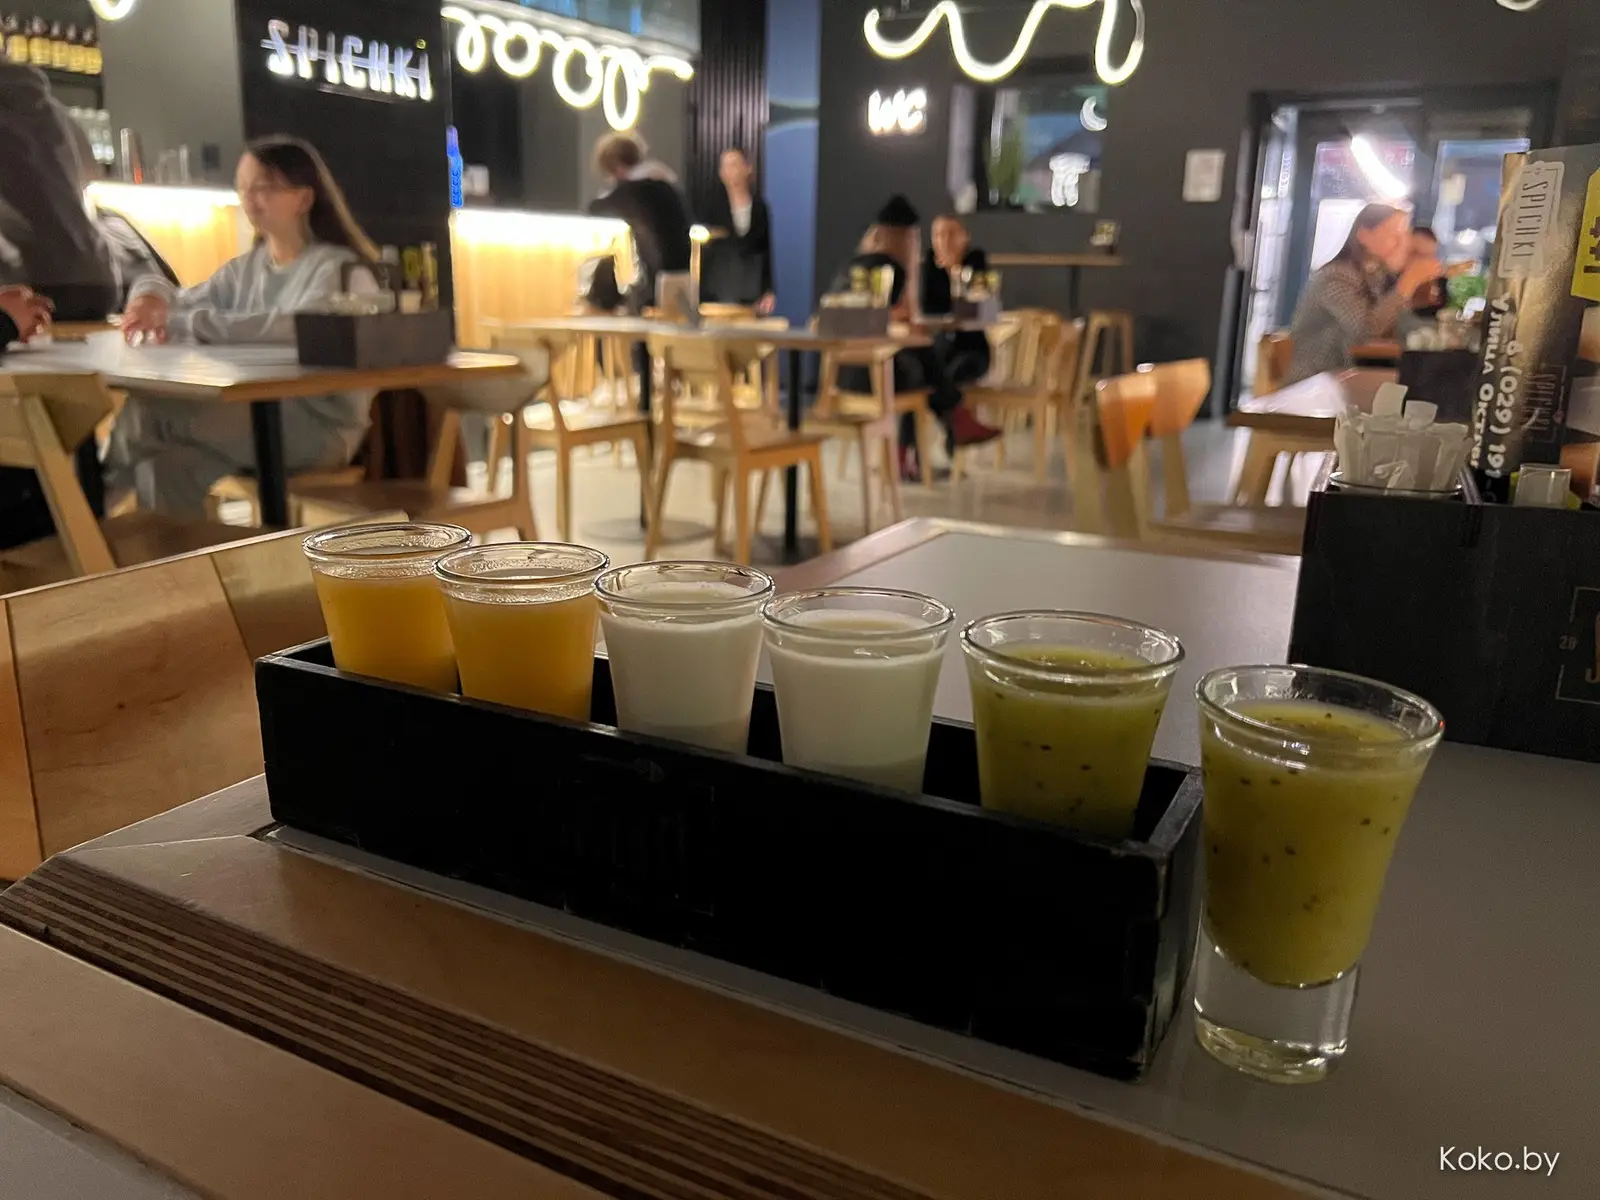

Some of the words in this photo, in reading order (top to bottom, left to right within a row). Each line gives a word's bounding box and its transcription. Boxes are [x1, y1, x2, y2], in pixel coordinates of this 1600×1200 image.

[868, 89, 928, 135] WC
[1511, 180, 1549, 257] SPICHKI
[1489, 366, 1522, 435] (029)
